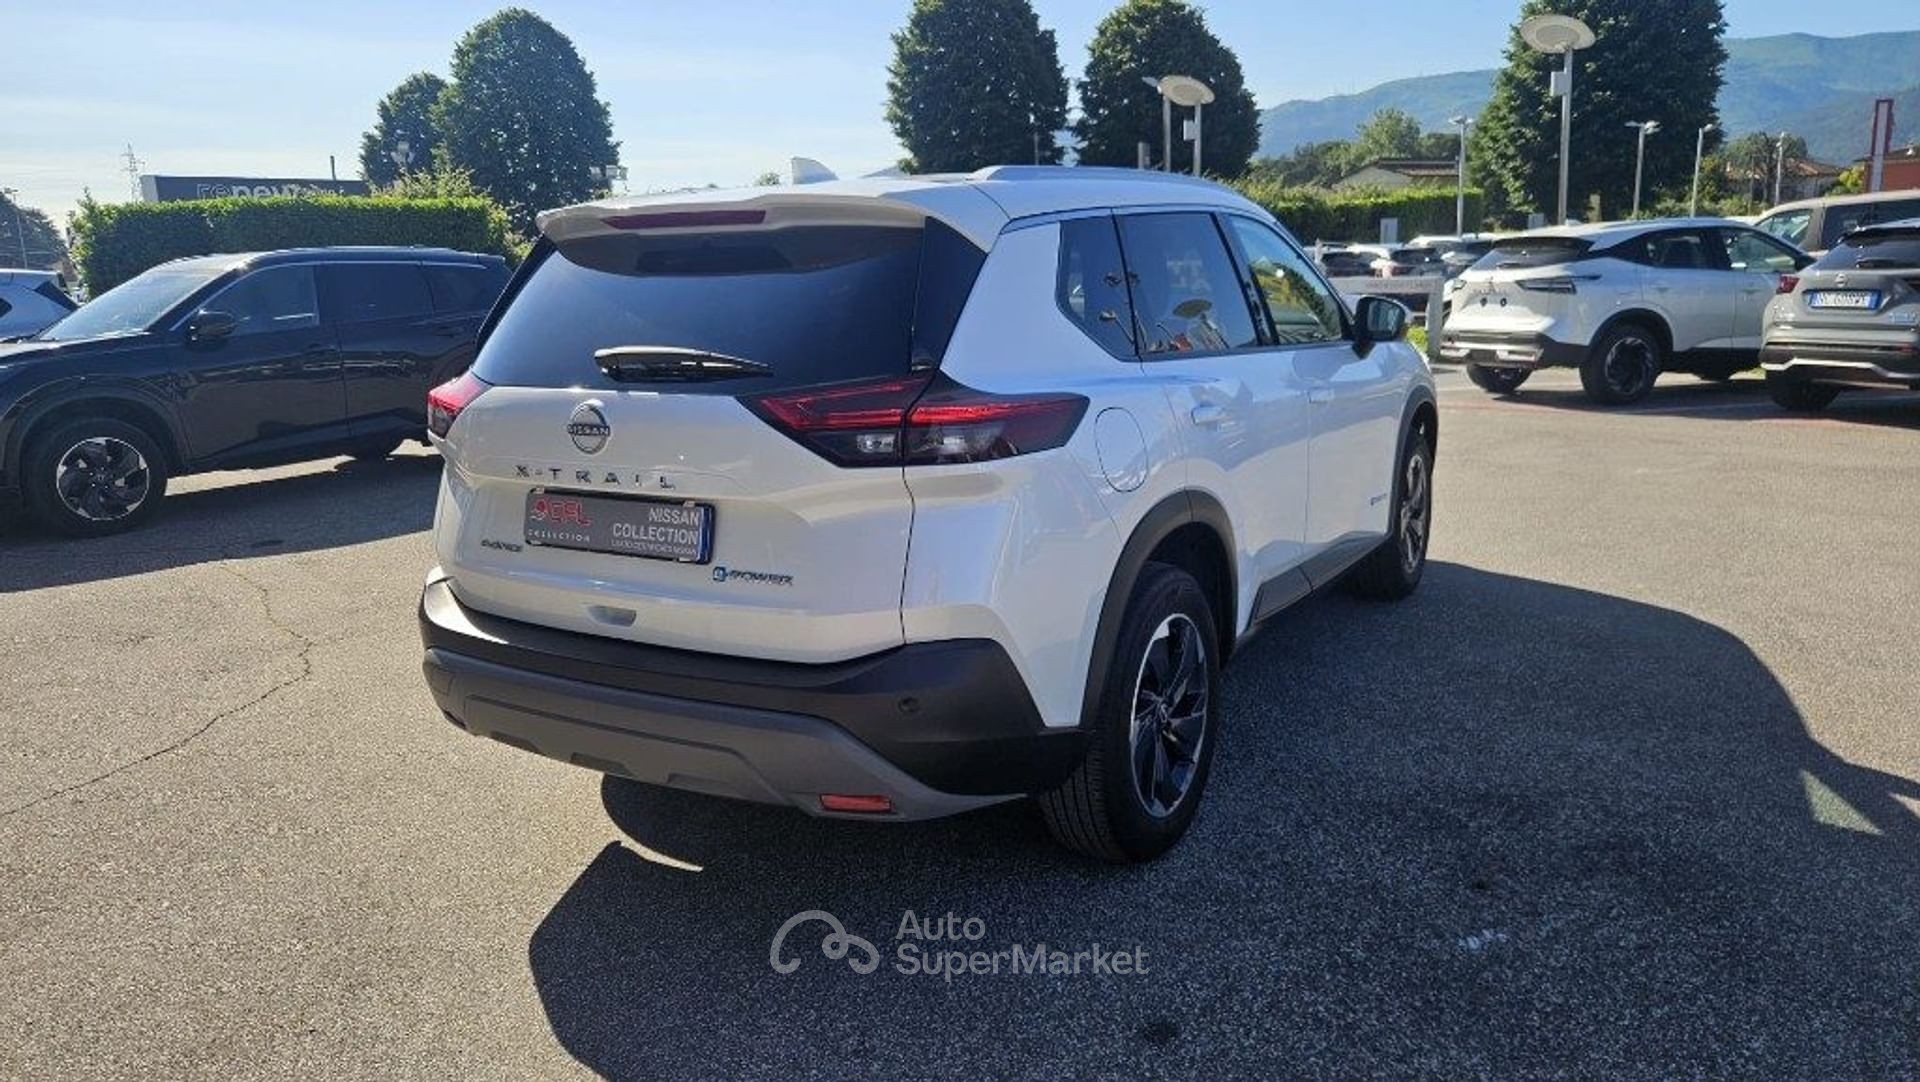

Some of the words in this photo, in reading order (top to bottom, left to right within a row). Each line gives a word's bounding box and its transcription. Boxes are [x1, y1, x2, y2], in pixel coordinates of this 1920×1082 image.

[567, 423, 611, 437] NISSAN
[515, 464, 676, 490] X-TRAIL
[649, 507, 699, 526] NISSAN
[612, 513, 698, 545] COLLECTION
